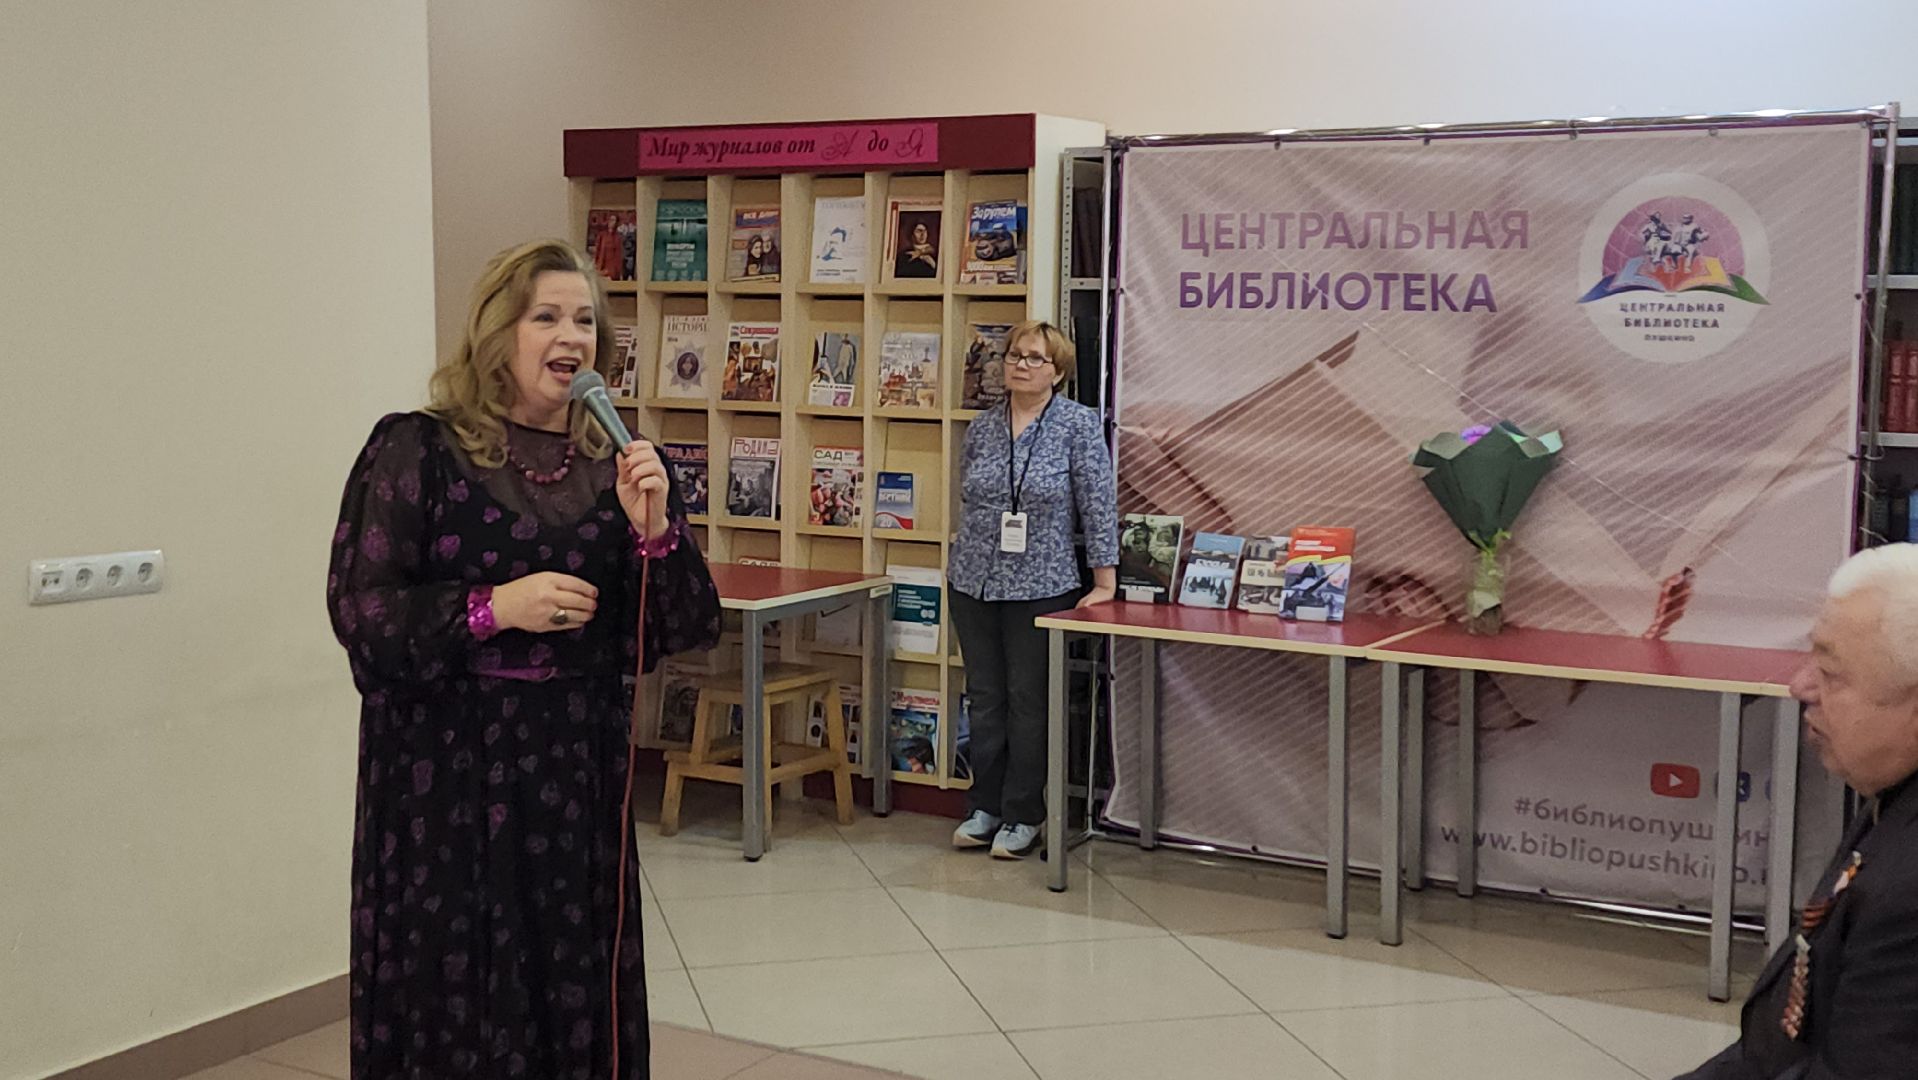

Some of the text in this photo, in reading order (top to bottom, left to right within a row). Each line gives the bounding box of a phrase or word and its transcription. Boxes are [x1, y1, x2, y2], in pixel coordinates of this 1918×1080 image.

[647, 138, 690, 164] Мир
[692, 139, 782, 165] журналов
[786, 138, 816, 154] от
[867, 129, 890, 154] до
[895, 129, 925, 158] Я
[1181, 211, 1528, 257] ЦЕНТРАЛЬНАЯ
[1180, 272, 1497, 312] БИБЛИОТЕКА
[1619, 302, 1725, 313] ЦЕНТРАЛЬНАЯ
[1624, 317, 1720, 329] БИБЛИОТЕКА
[815, 449, 843, 461] САД
